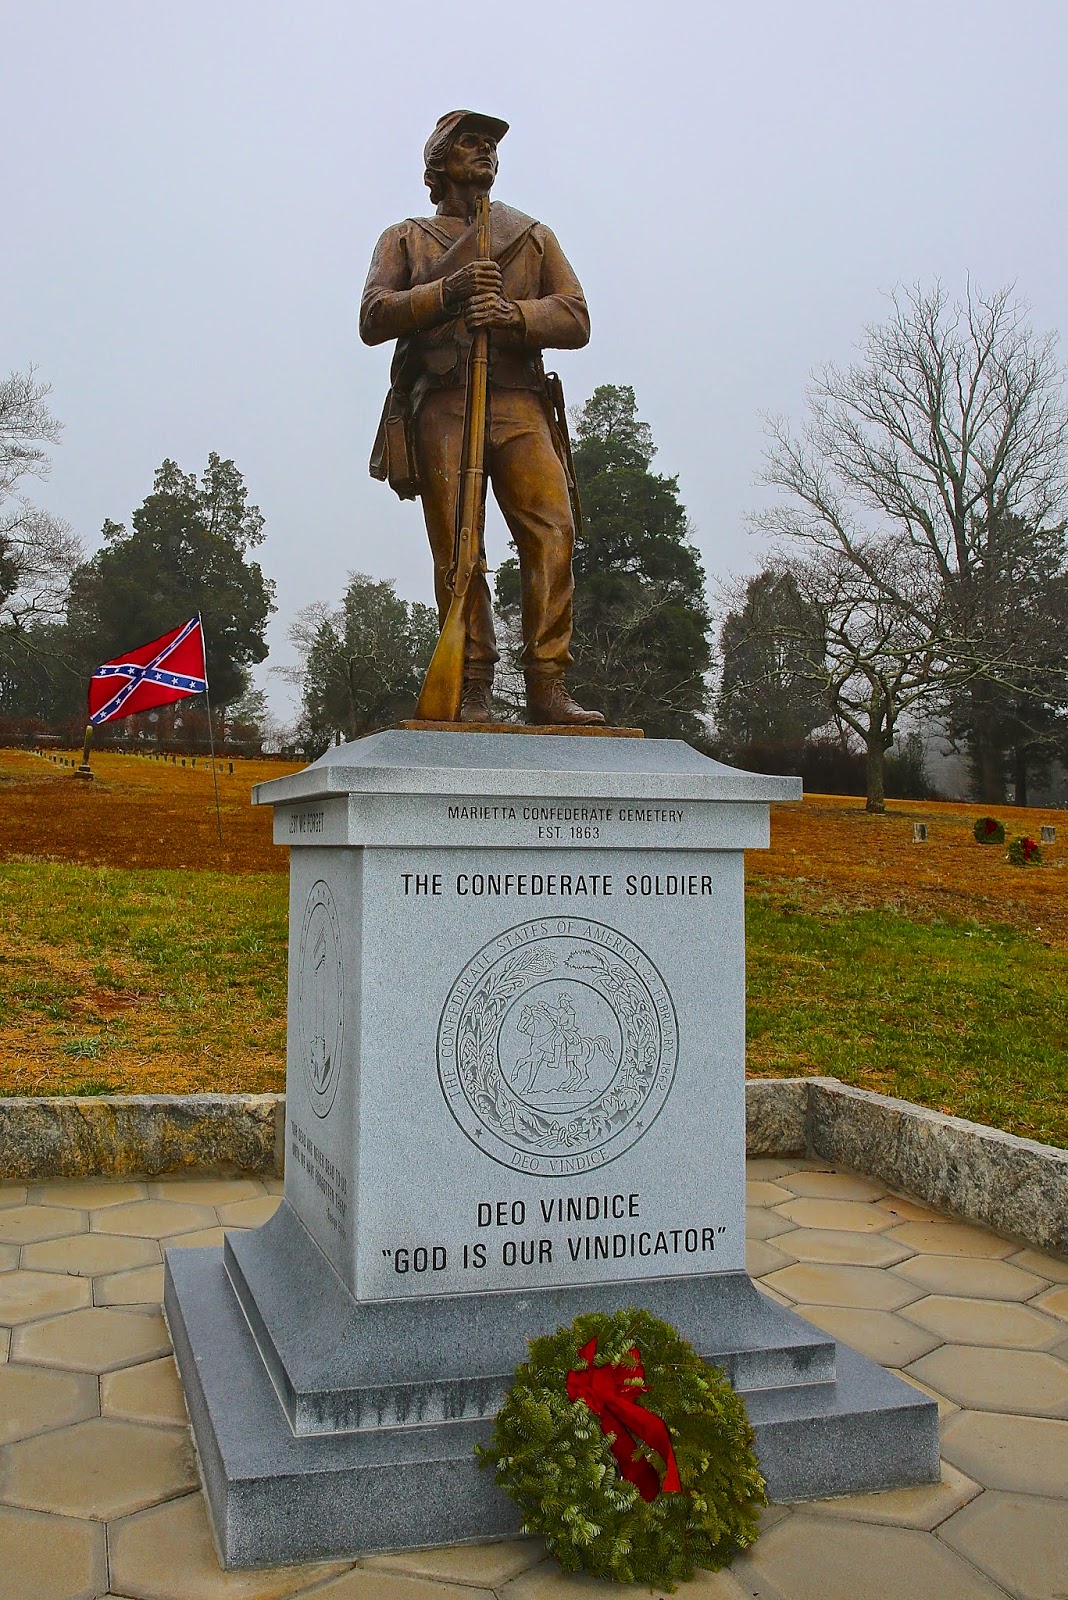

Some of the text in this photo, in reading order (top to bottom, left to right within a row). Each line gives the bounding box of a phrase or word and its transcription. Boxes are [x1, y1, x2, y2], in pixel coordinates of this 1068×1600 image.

[447, 806, 684, 823] MARIETTA CONFEDERATE CEMETERY
[537, 827, 600, 840] EST. 1863
[401, 874, 713, 897] THE CONFEDERATE SOLDIER
[441, 920, 674, 1102] THE CONFEDERATE STATES OF AMERICA 22 FEBRUARY 1862
[511, 1147, 610, 1173] DEO VINDICE
[477, 1193, 640, 1228] DEO VINDICE
[462, 1243, 487, 1269] IS
[502, 1239, 553, 1267] OUR
